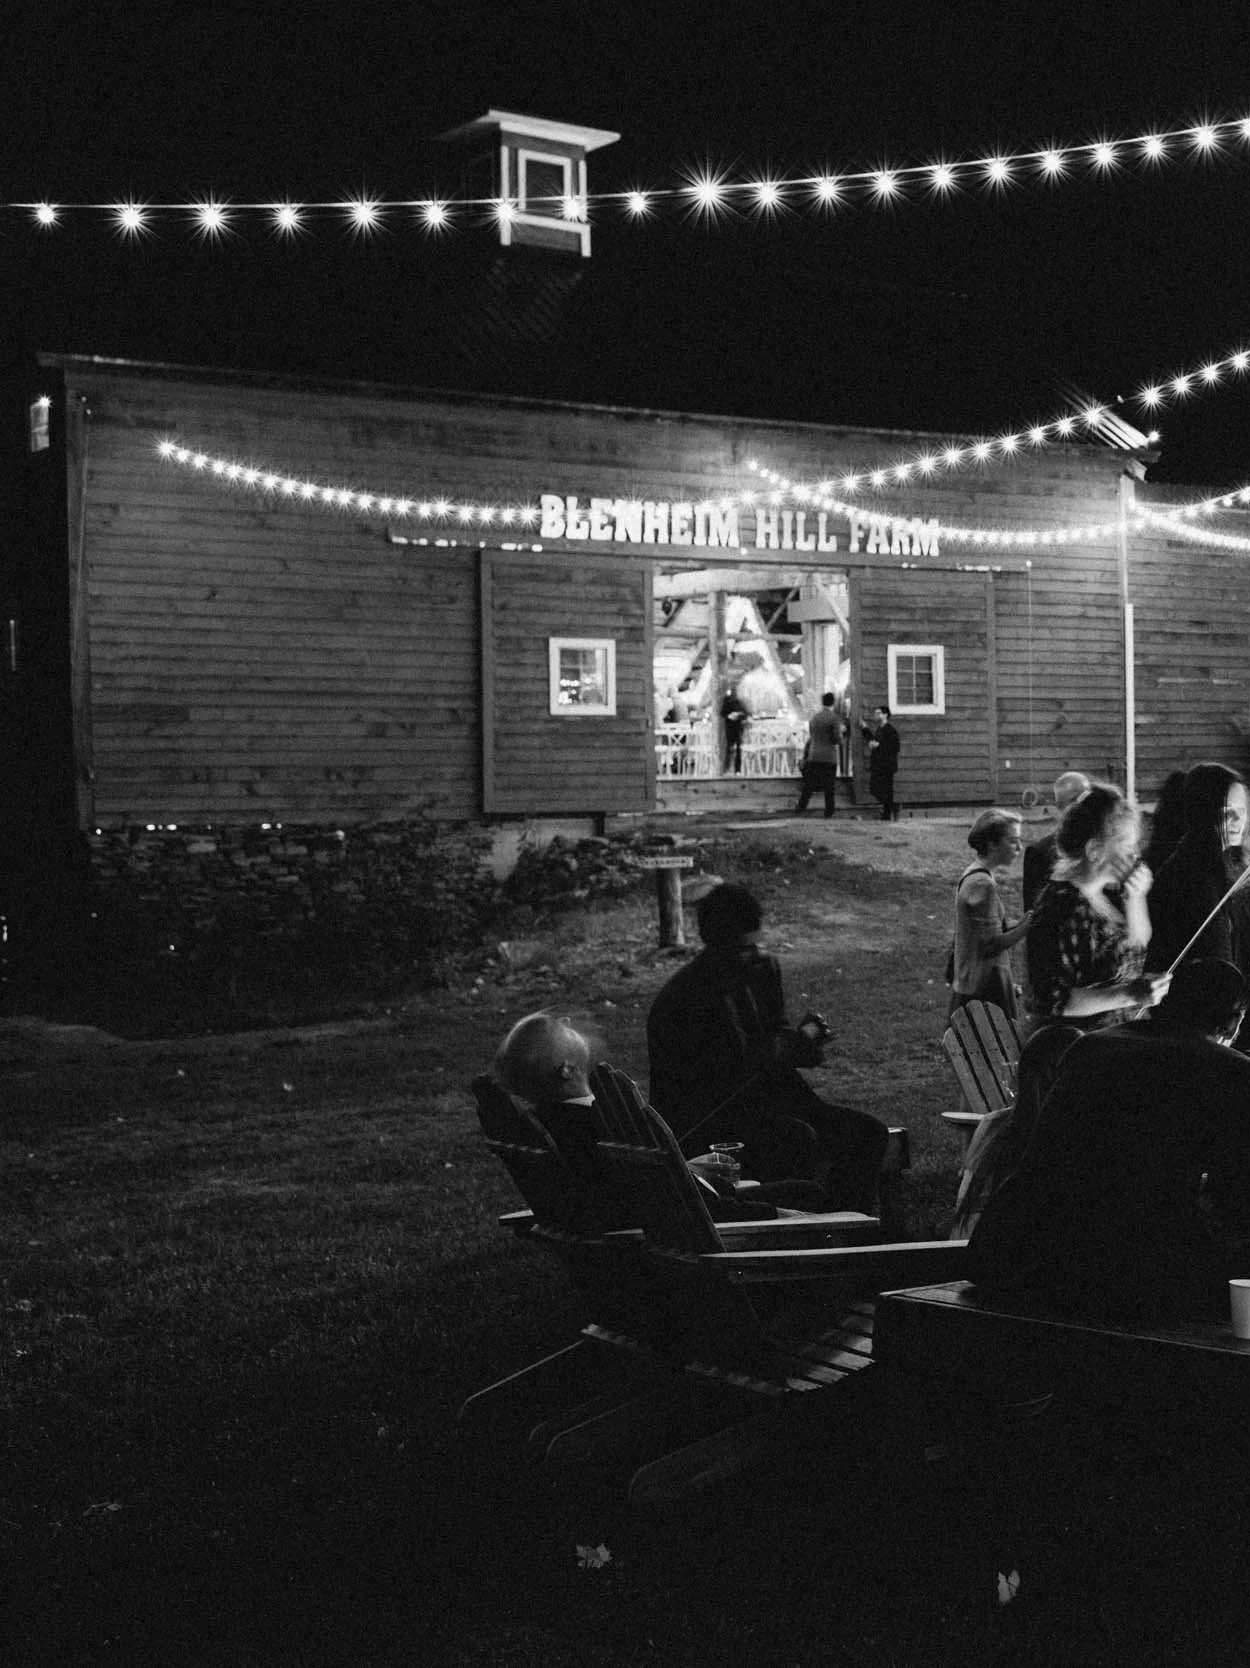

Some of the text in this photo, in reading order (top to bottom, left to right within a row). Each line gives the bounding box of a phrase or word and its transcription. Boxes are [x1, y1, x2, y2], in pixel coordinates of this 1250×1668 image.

[540, 494, 939, 556] BLENHEIM HILL FARM
